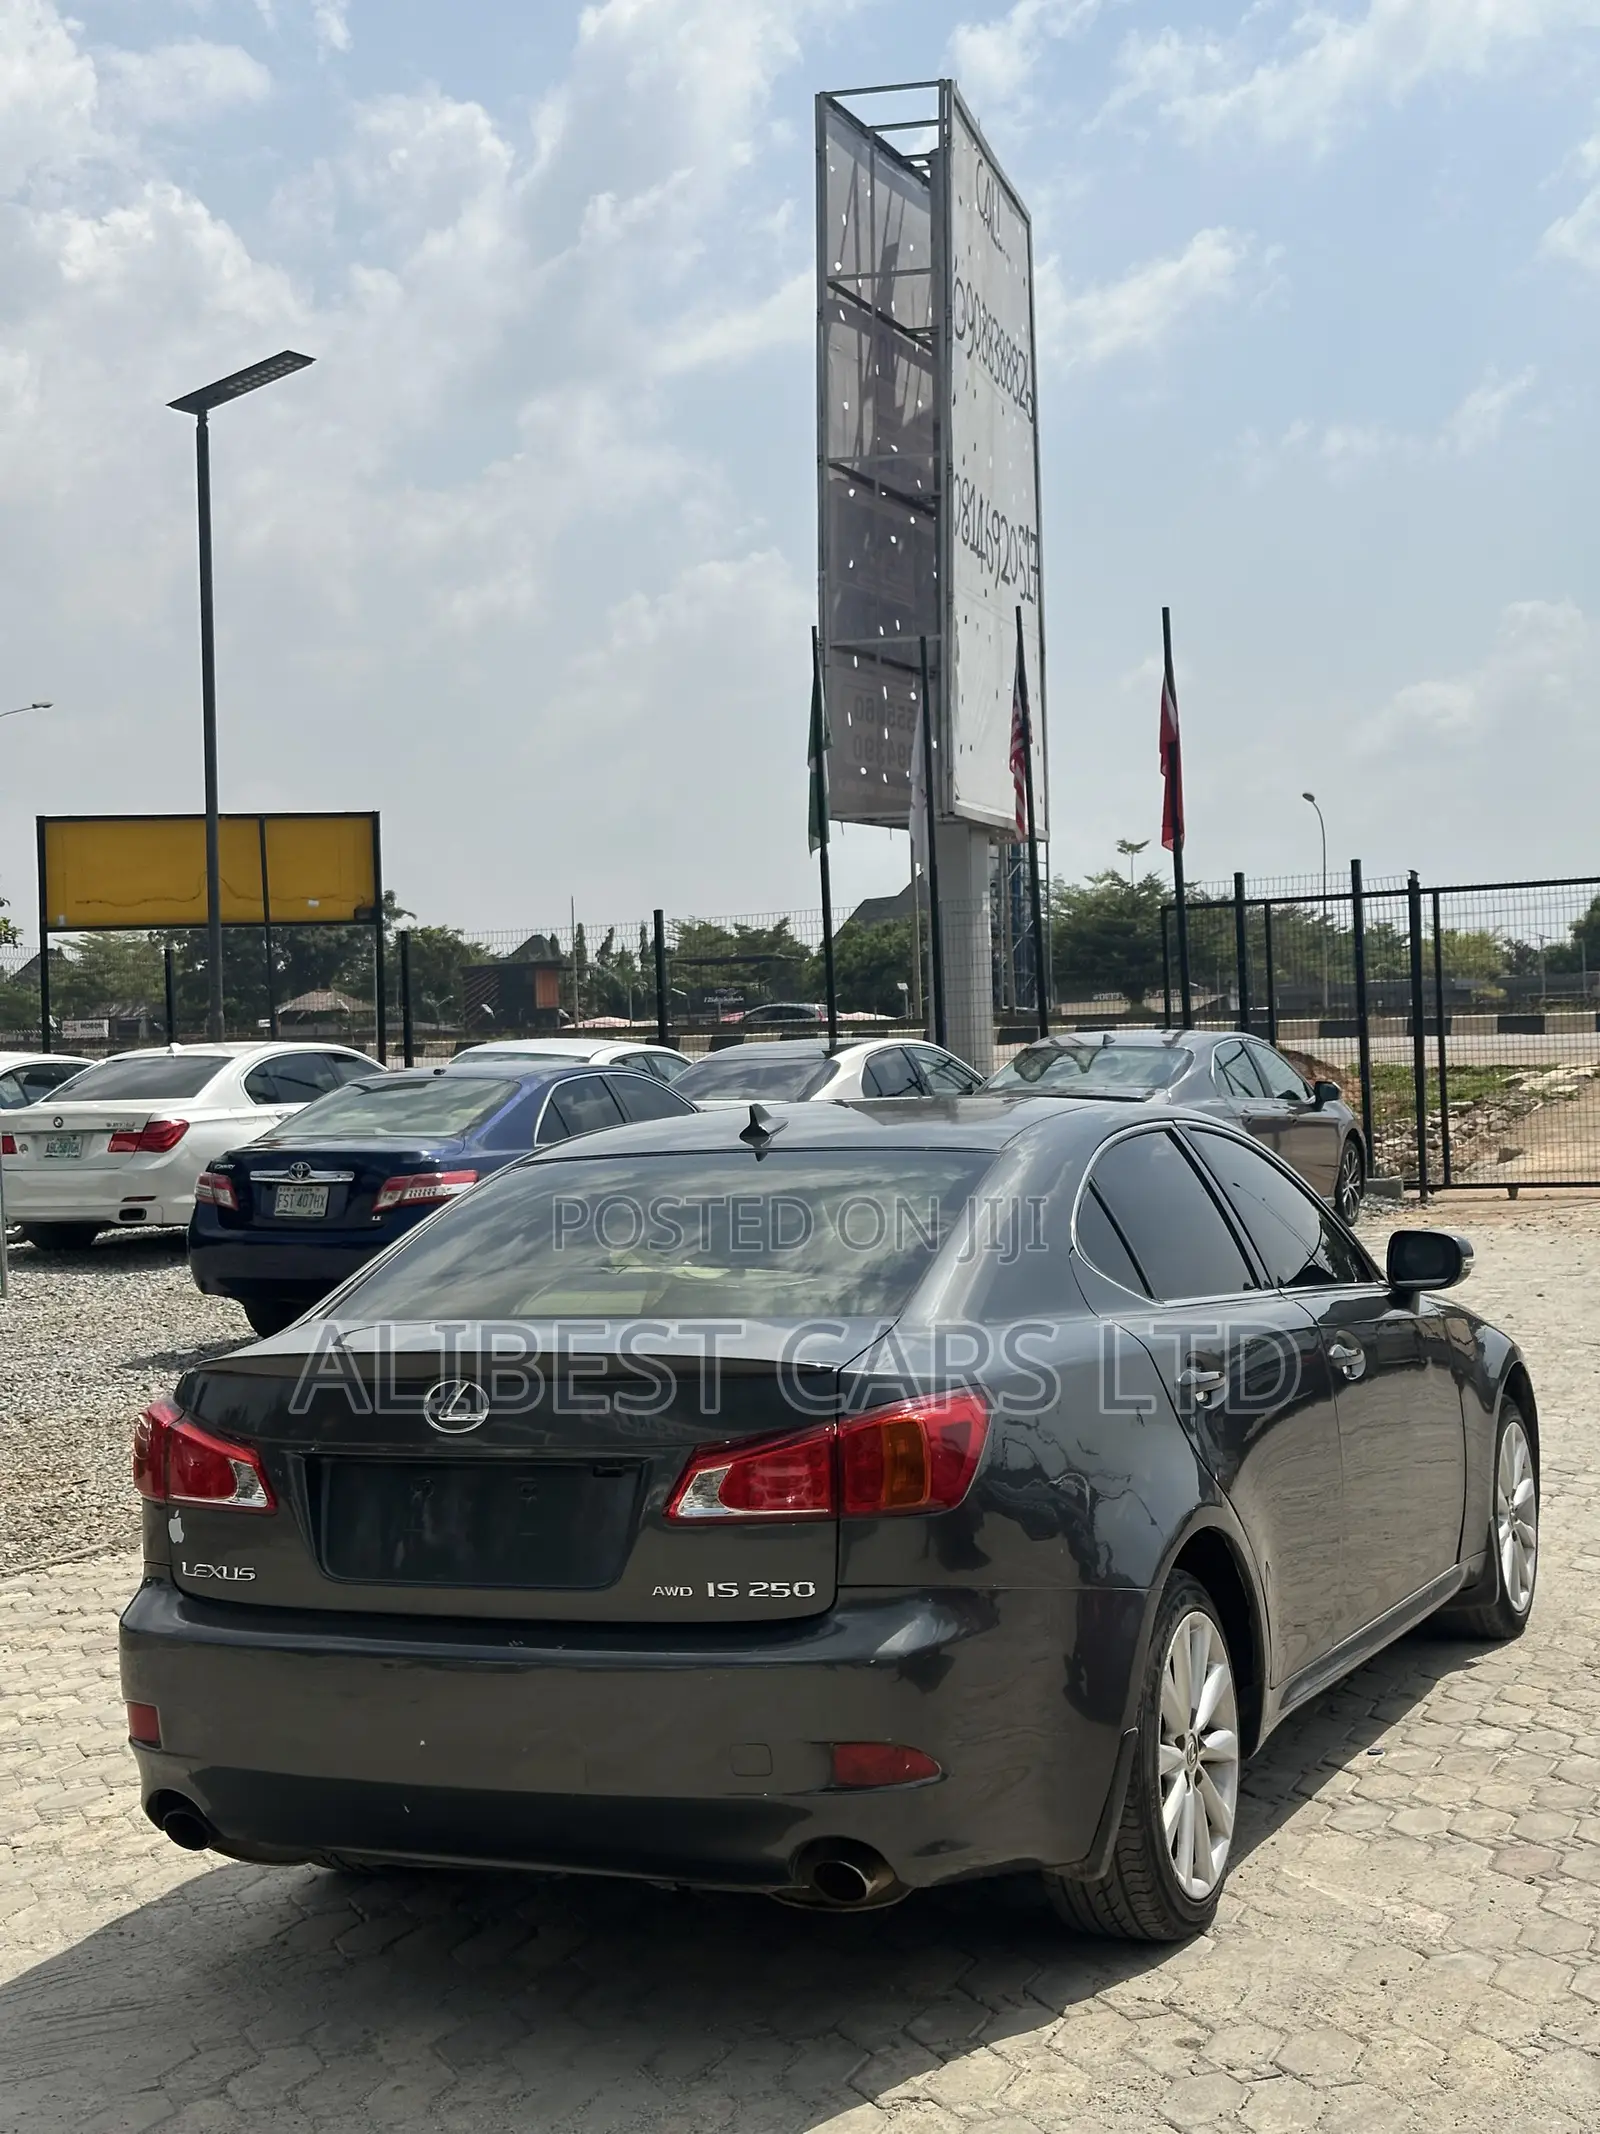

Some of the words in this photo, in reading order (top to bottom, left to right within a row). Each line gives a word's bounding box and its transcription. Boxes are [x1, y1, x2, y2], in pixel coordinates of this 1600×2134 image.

[976, 158, 1005, 253] CALL
[181, 1561, 256, 1581] LEXUS
[652, 1585, 694, 1597] AWD
[707, 1582, 739, 1598] IS
[748, 1581, 816, 1598] 250
